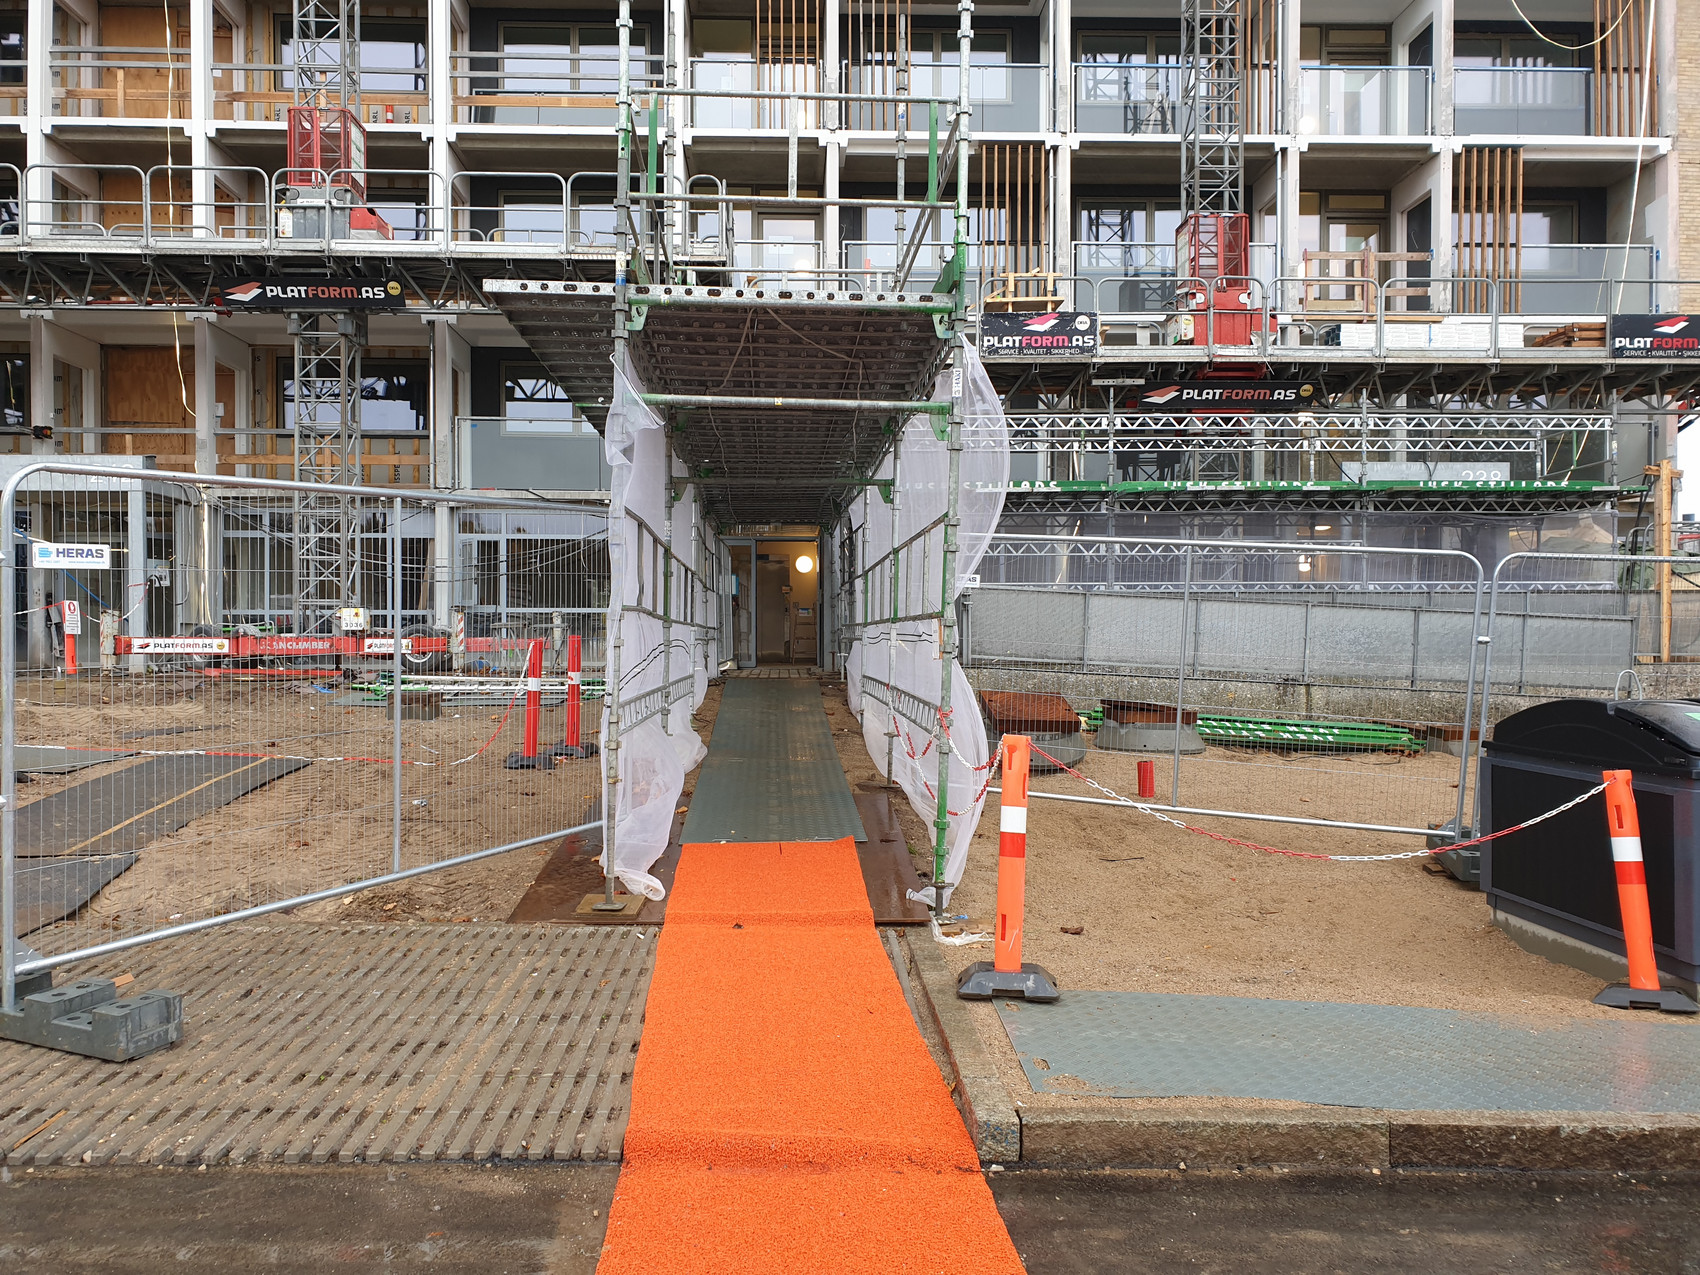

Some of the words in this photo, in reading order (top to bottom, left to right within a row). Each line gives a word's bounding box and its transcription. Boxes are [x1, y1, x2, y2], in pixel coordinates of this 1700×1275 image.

[265, 285, 385, 299] PLATFORM.AS
[983, 335, 1095, 348] PLATFORM.AS
[1182, 389, 1297, 400] PLATFORM.AS
[55, 547, 105, 559] HERAS
